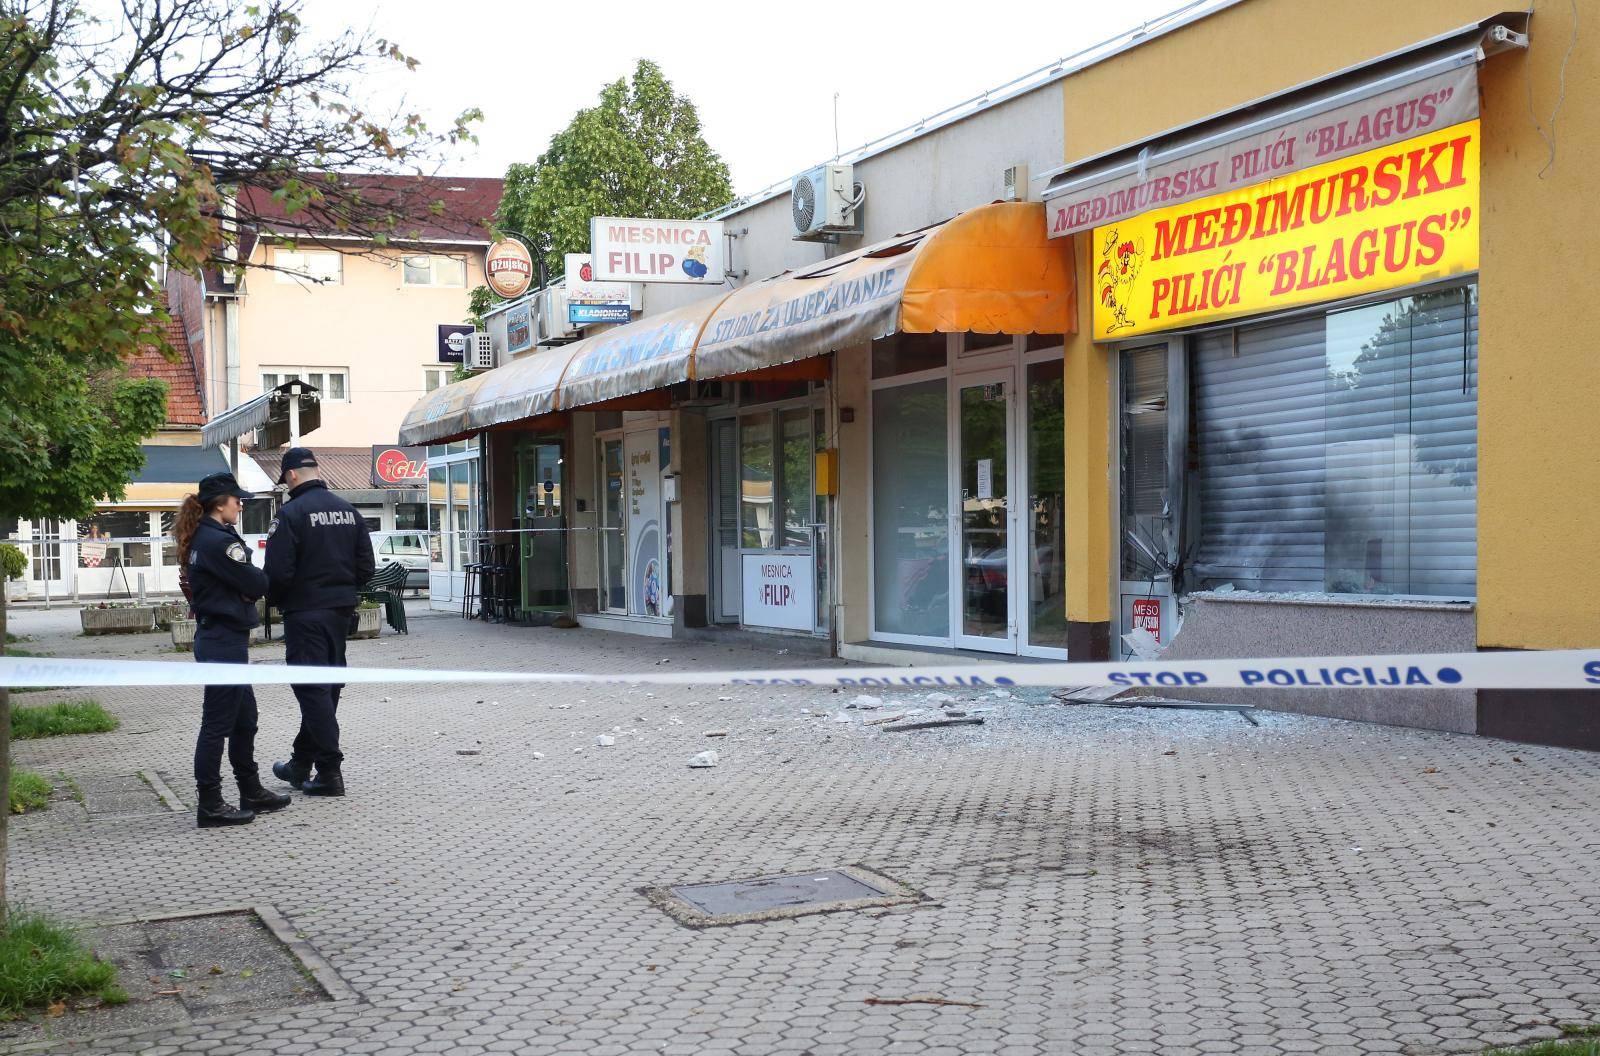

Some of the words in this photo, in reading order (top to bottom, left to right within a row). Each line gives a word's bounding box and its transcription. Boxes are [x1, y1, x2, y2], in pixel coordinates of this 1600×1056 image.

[1054, 161, 1219, 233] MEĐIMURSKI
[1230, 131, 1297, 183] PILIĆI
[1150, 135, 1472, 261] MEĐIMURSKI
[609, 226, 711, 245] MESNICA
[609, 252, 674, 274] FILIP
[1149, 249, 1247, 319] PILIĆI
[577, 309, 628, 317] KLADIONICA
[713, 310, 764, 343] STUDIO
[759, 304, 782, 333] ZA
[310, 511, 356, 527] POLICIJA
[761, 564, 792, 578] MESNICA
[764, 584, 790, 606] FILIP
[1134, 604, 1159, 616] MESO
[1107, 671, 1208, 686] STOP
[1239, 666, 1433, 686] POLICIJA
